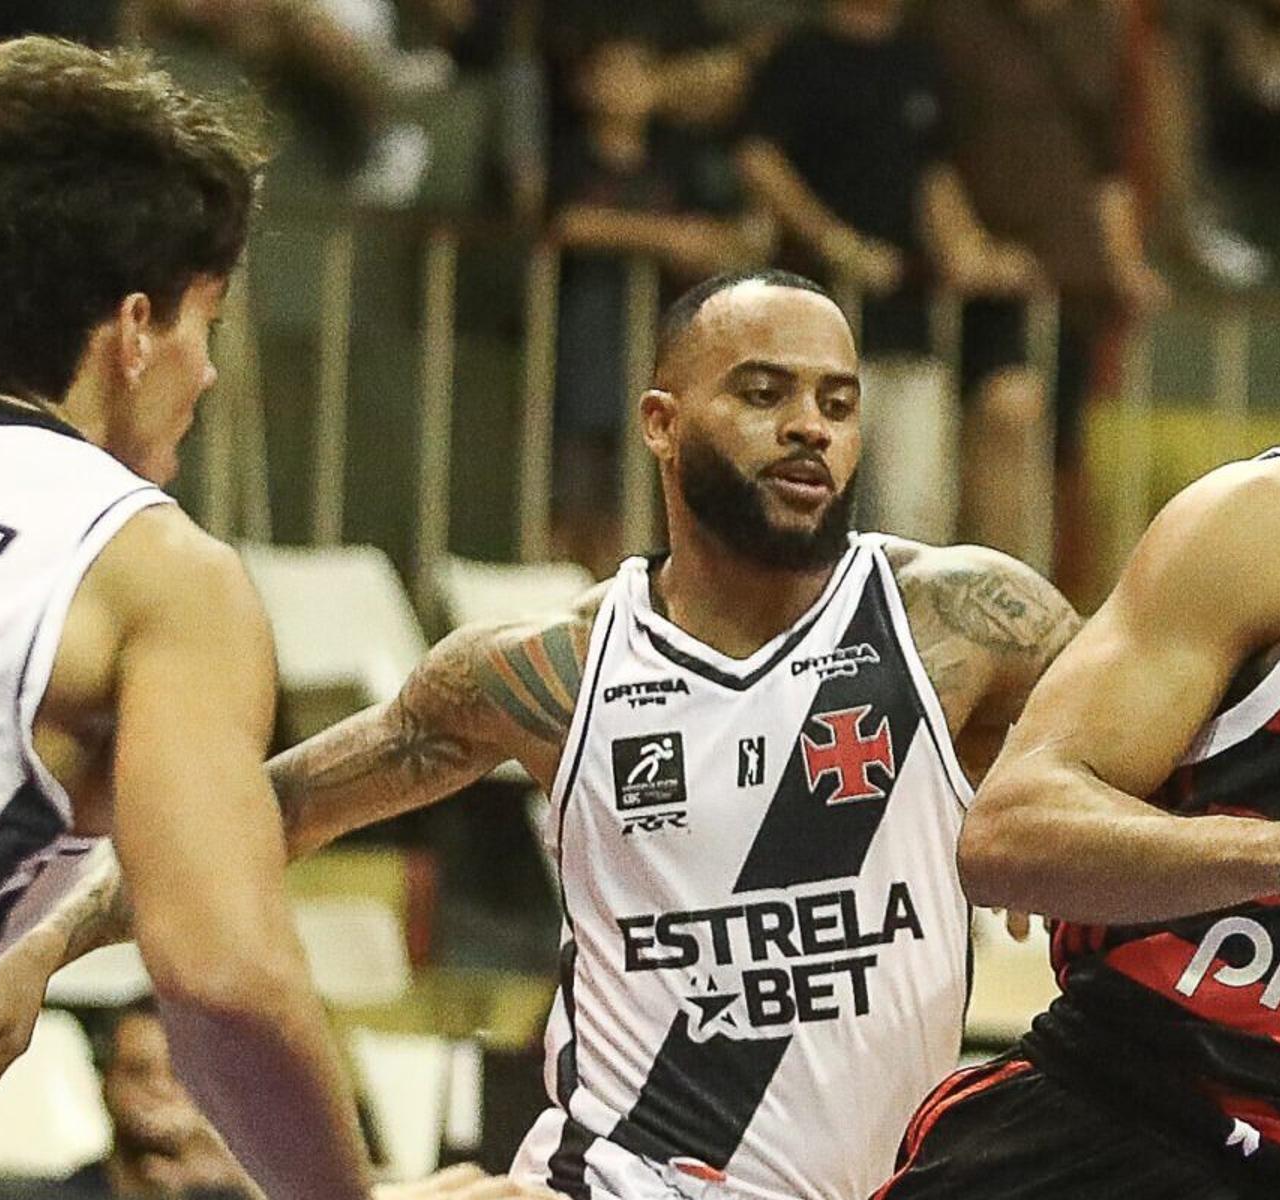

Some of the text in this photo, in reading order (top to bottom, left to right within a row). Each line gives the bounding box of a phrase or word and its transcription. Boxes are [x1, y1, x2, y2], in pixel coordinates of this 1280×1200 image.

[604, 678, 690, 703] ORTEGA
[616, 881, 925, 972] ESTRELA
[742, 953, 878, 1028] BET
